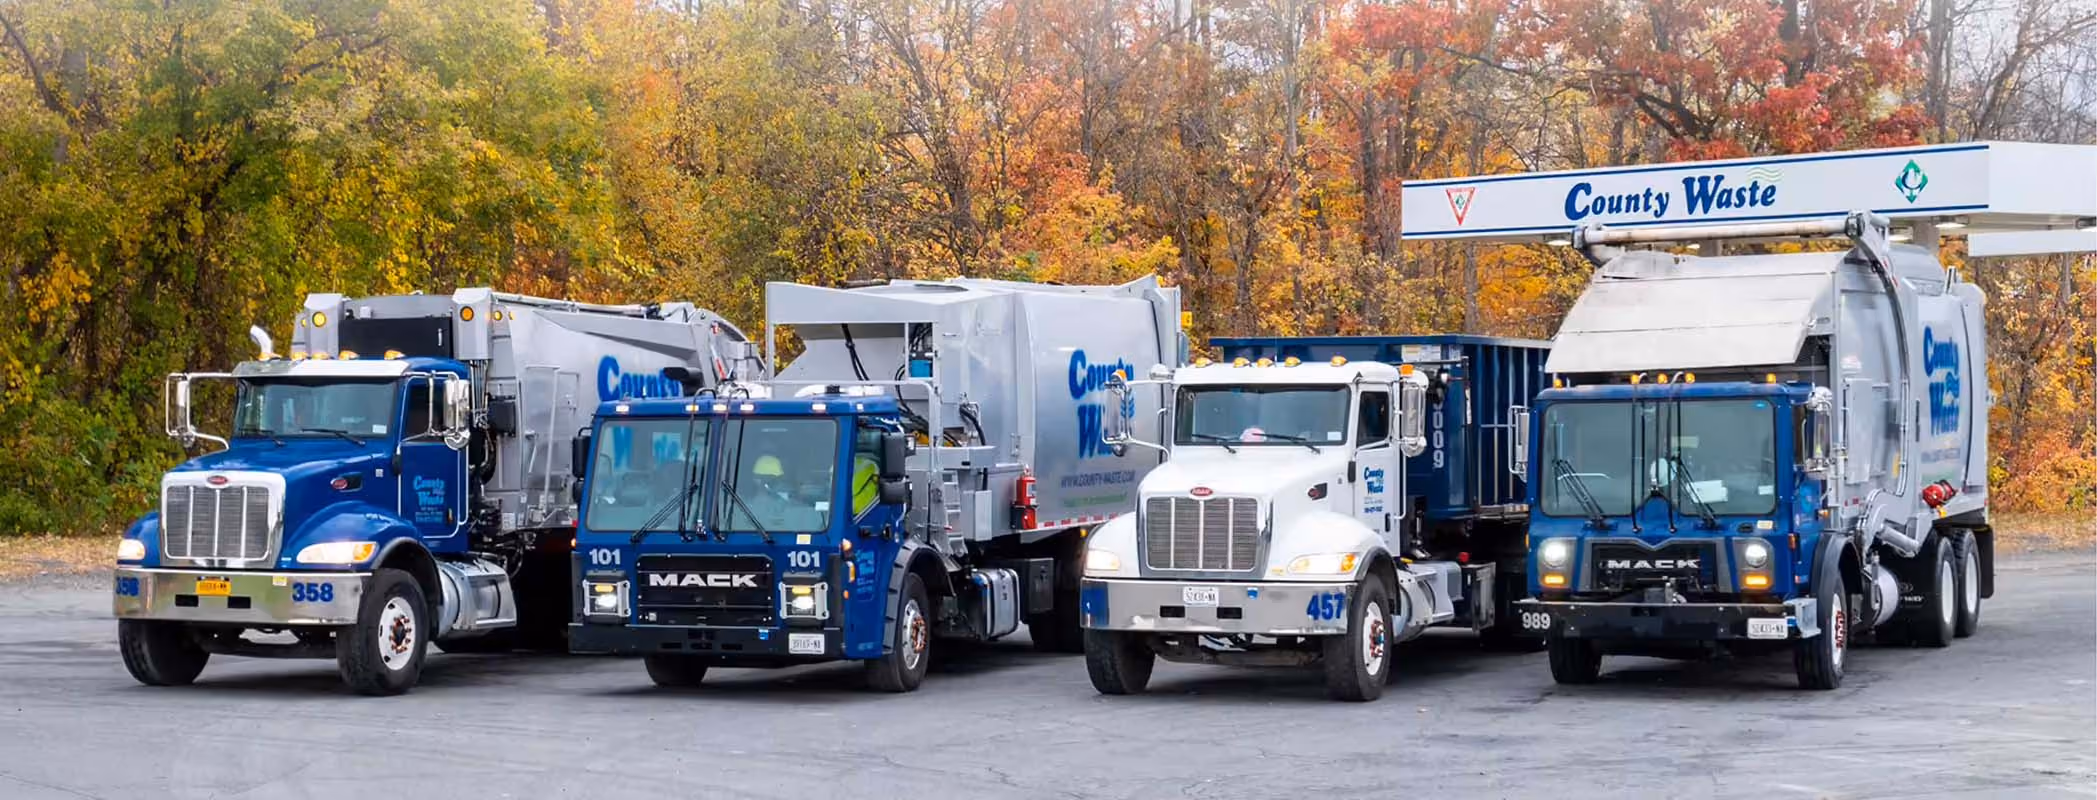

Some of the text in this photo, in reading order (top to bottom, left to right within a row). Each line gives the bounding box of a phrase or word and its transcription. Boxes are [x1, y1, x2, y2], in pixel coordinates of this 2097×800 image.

[1564, 174, 1777, 221] County Waste
[589, 548, 621, 566] 101
[787, 551, 821, 568] 101
[1607, 559, 1701, 570] MACK
[649, 573, 758, 588] MACK
[291, 582, 335, 603] 358
[1306, 592, 1346, 621] 457
[1521, 611, 1551, 630] 989
